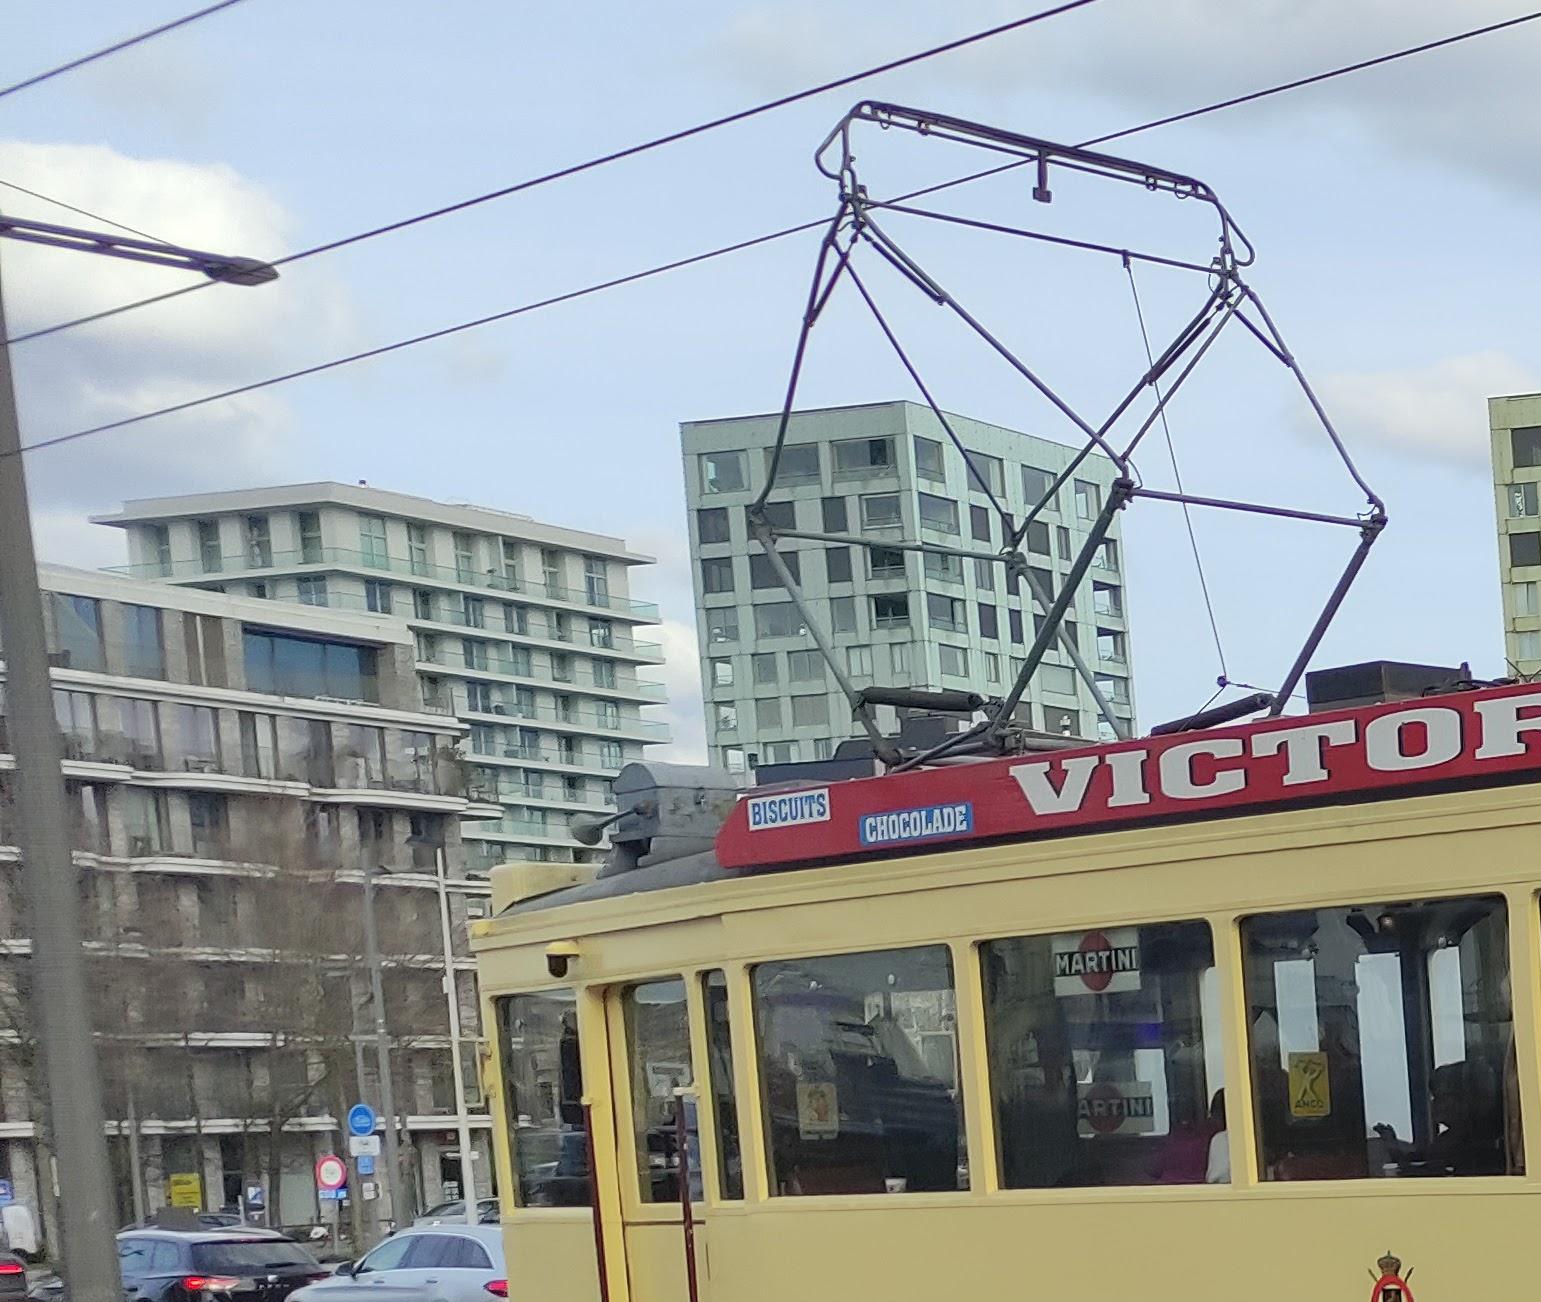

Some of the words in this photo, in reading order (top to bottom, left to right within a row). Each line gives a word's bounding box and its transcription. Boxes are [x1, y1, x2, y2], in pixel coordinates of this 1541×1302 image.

[751, 793, 827, 827] BISCUITS
[864, 804, 968, 844] CHOCOLADE
[1055, 948, 1137, 976] MARTINI
[1078, 1097, 1152, 1119] ARTINI
